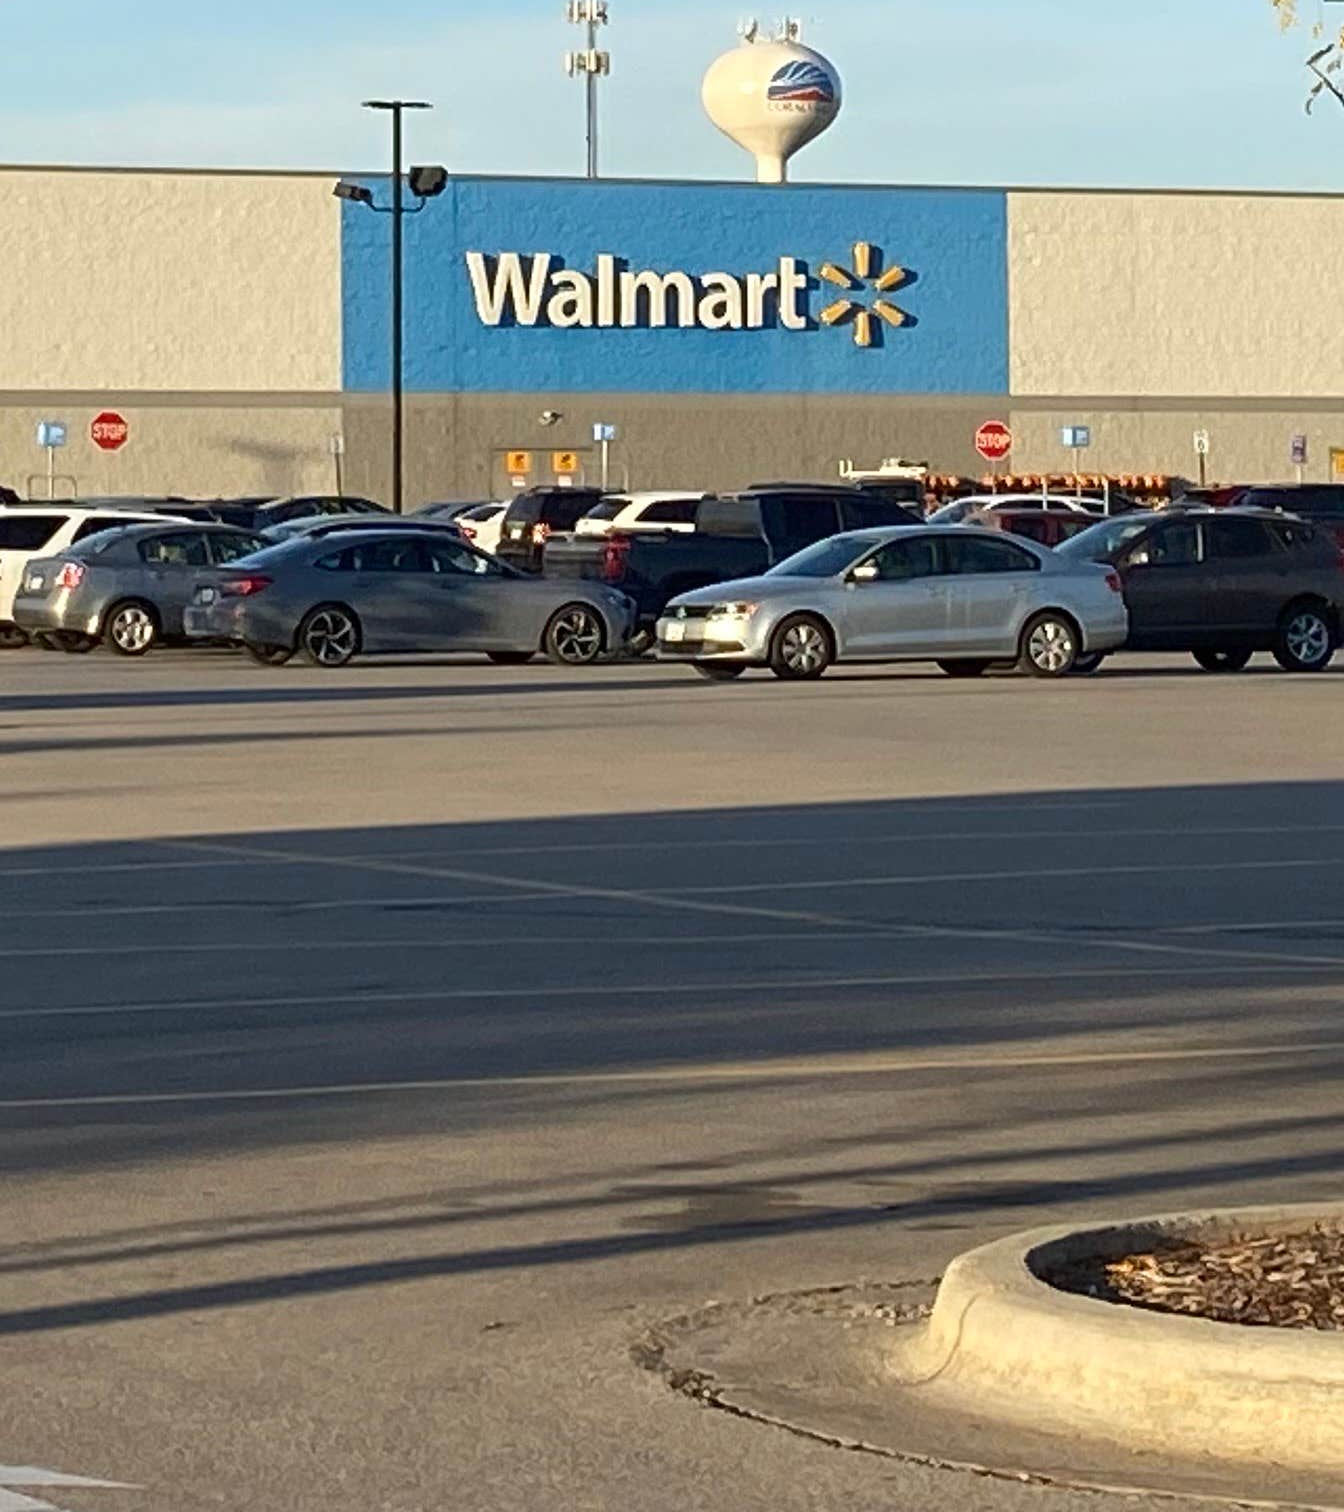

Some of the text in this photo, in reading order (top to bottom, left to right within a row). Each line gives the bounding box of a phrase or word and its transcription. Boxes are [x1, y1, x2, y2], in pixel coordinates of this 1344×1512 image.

[466, 251, 806, 329] Walmart
[93, 422, 125, 439] STOP
[977, 433, 1010, 448] STOP
